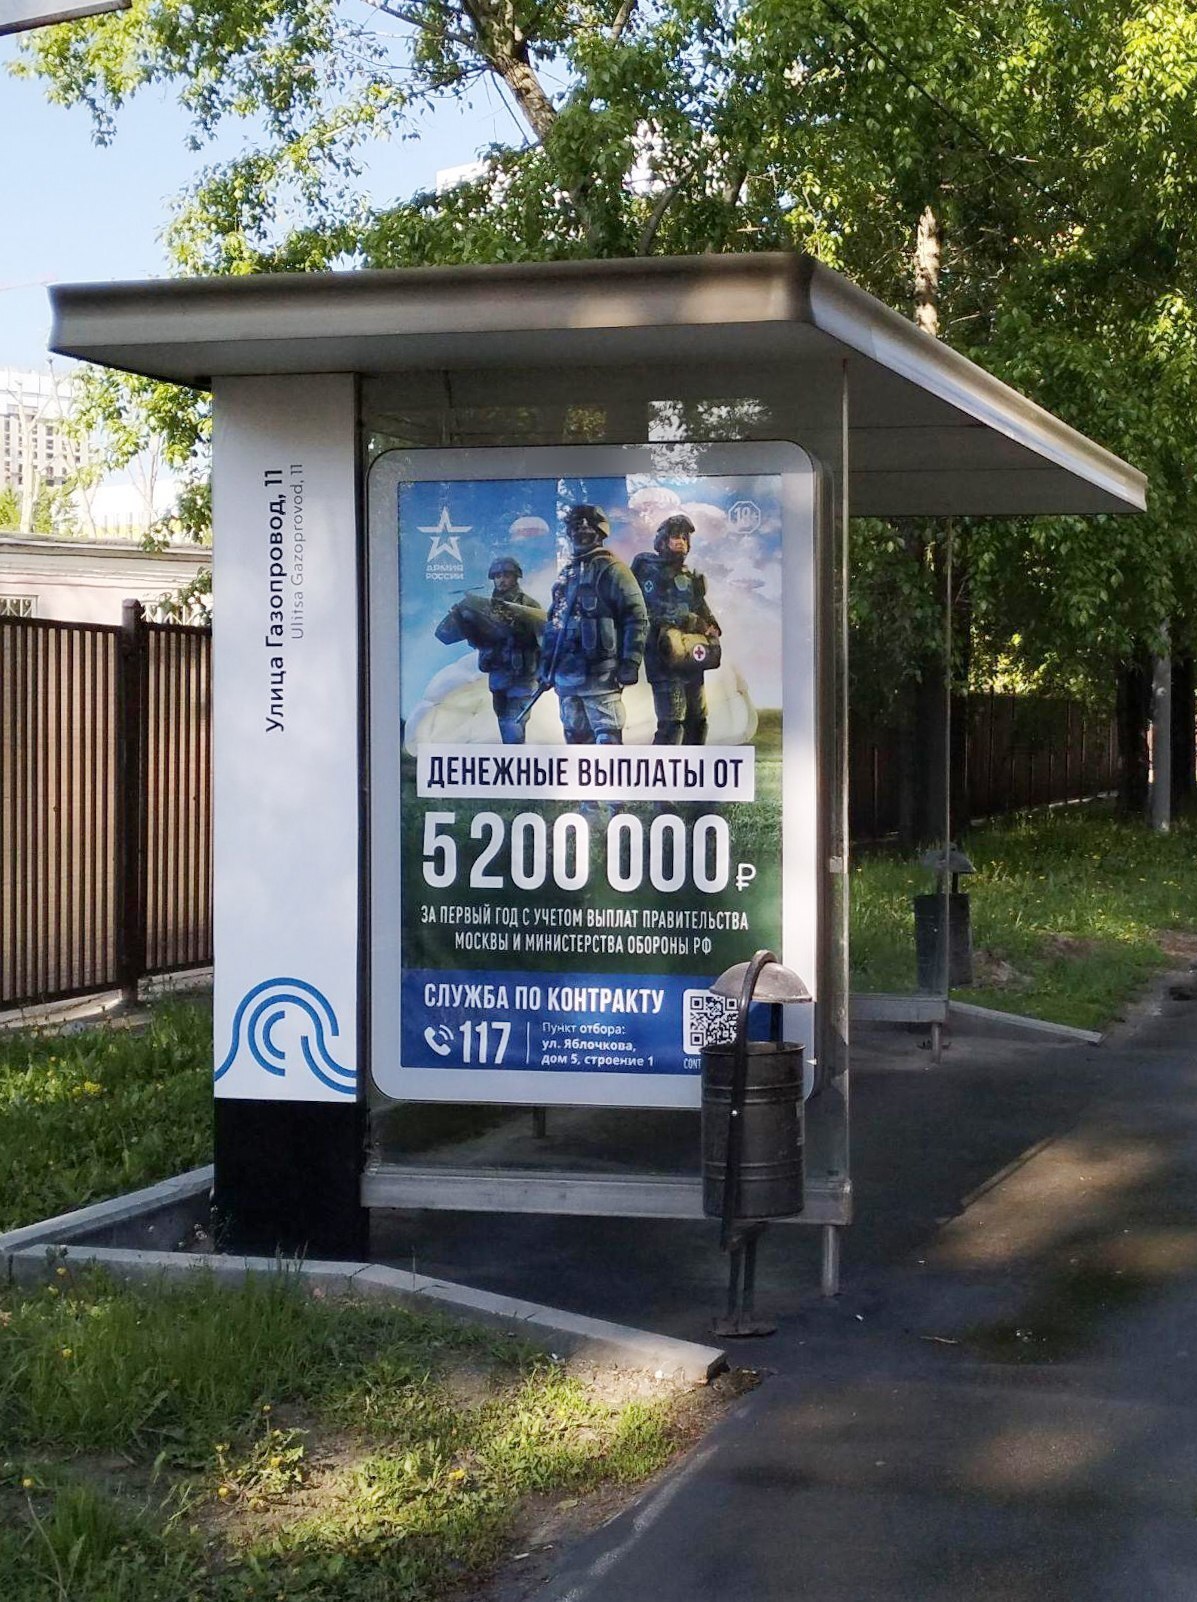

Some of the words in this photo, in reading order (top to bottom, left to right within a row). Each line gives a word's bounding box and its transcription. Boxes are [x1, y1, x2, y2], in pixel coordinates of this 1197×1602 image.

[265, 469, 283, 487] 11
[290, 463, 303, 475] 11
[290, 479, 306, 586] Gazoprovod,
[265, 494, 288, 648] Газопровод,
[425, 572, 465, 580] РОССИИ
[426, 564, 464, 572] АРМИЯ
[291, 591, 303, 639] Ulitsa
[265, 656, 287, 732] Улица
[427, 756, 568, 789] ДЕНЕЖНЫЕ
[578, 758, 704, 788] ВЫПЛАТЫ
[714, 759, 743, 788] ОТ
[422, 811, 457, 889] 5
[469, 812, 589, 891] 200
[607, 813, 730, 893] 000
[420, 905, 437, 924] ЗА
[440, 903, 491, 926] ПЕРВЫЙ
[495, 907, 519, 928] ГОД
[522, 908, 530, 926] С
[534, 908, 583, 928] УЧЕТОМ
[587, 909, 639, 928] ВЫПЛАТ
[642, 910, 749, 930] ПРАВИТЕЛЬСТВА
[454, 931, 509, 951] МОСКВЫ
[512, 933, 521, 951] И
[525, 933, 624, 954] МИНИСТЕРСТВА
[628, 935, 689, 955] ОБОРОНЫ
[693, 936, 712, 956] РФ
[423, 983, 509, 1010] СЛУЖБА
[514, 986, 541, 1011] ПО
[547, 987, 664, 1014] КОНТРАКТУ
[458, 1020, 511, 1064] 117
[542, 1022, 577, 1034] Пункт
[579, 1022, 626, 1036] отбора:
[541, 1039, 561, 1051] ул.
[563, 1039, 636, 1053] Яблочкова,
[541, 1054, 568, 1066] дом
[571, 1053, 581, 1065] 5,
[584, 1055, 644, 1067] строение
[647, 1056, 654, 1066] 1
[683, 1057, 701, 1069] CONT
